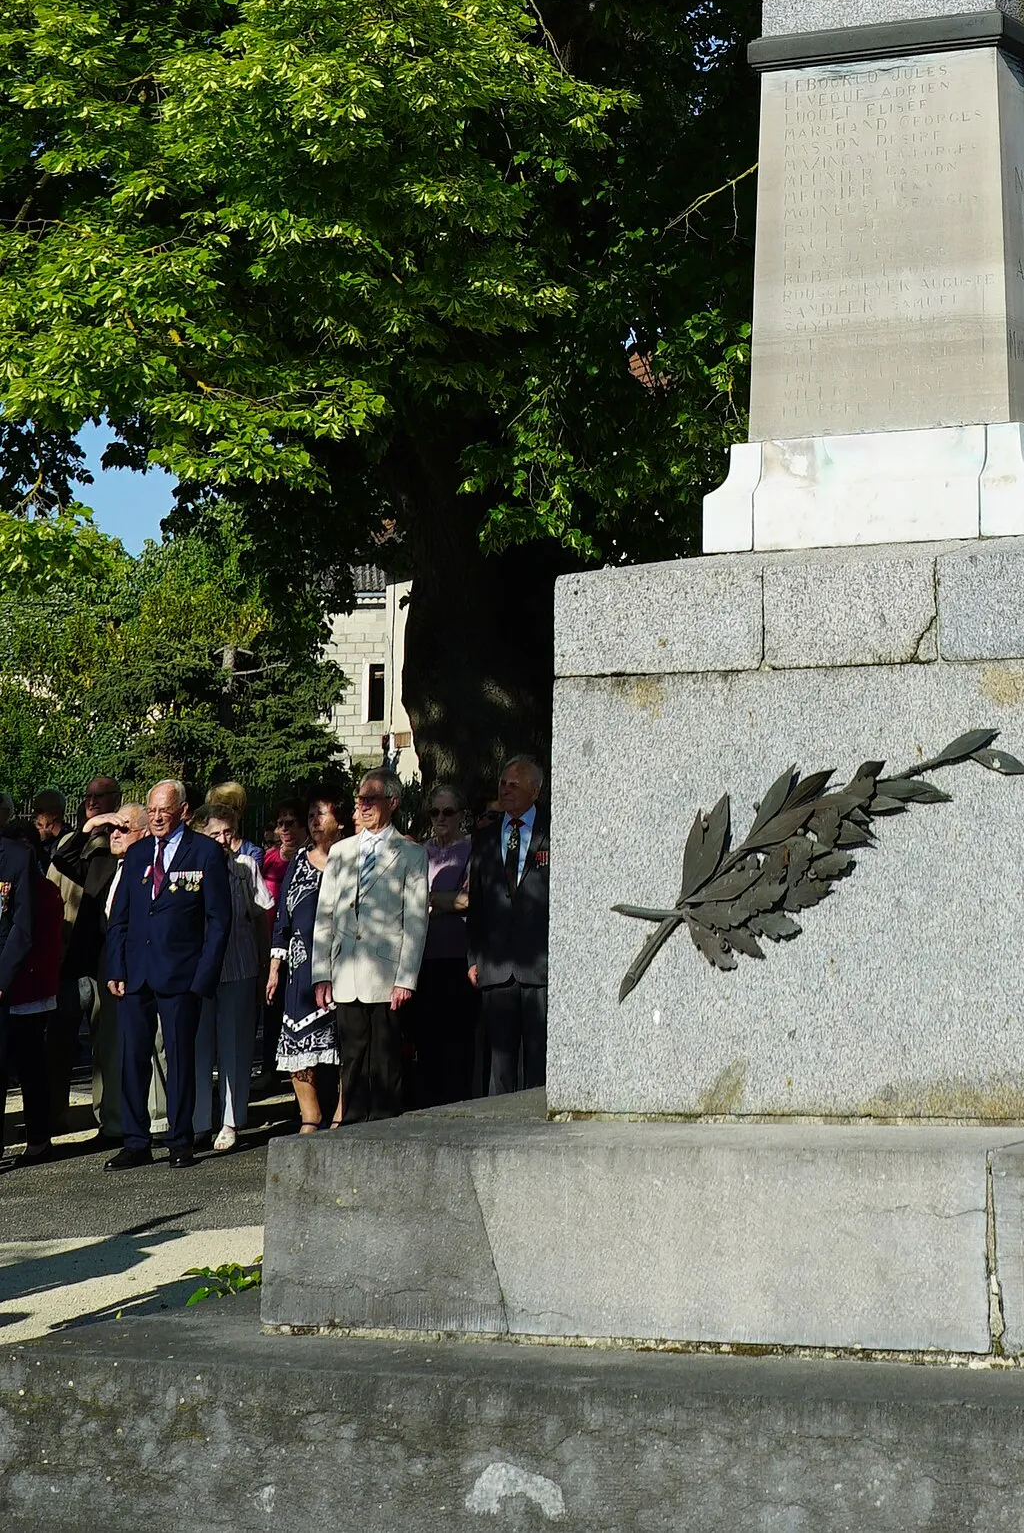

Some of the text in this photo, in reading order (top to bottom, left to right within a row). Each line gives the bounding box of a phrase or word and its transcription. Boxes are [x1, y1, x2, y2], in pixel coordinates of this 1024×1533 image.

[892, 65, 947, 82] JULES
[881, 81, 950, 99] ADRIEN
[784, 106, 851, 126] LUQUET
[784, 110, 983, 141] MARCHAND GEORGES
[784, 138, 860, 157] MASSON
[784, 167, 872, 189] MEUNIER
